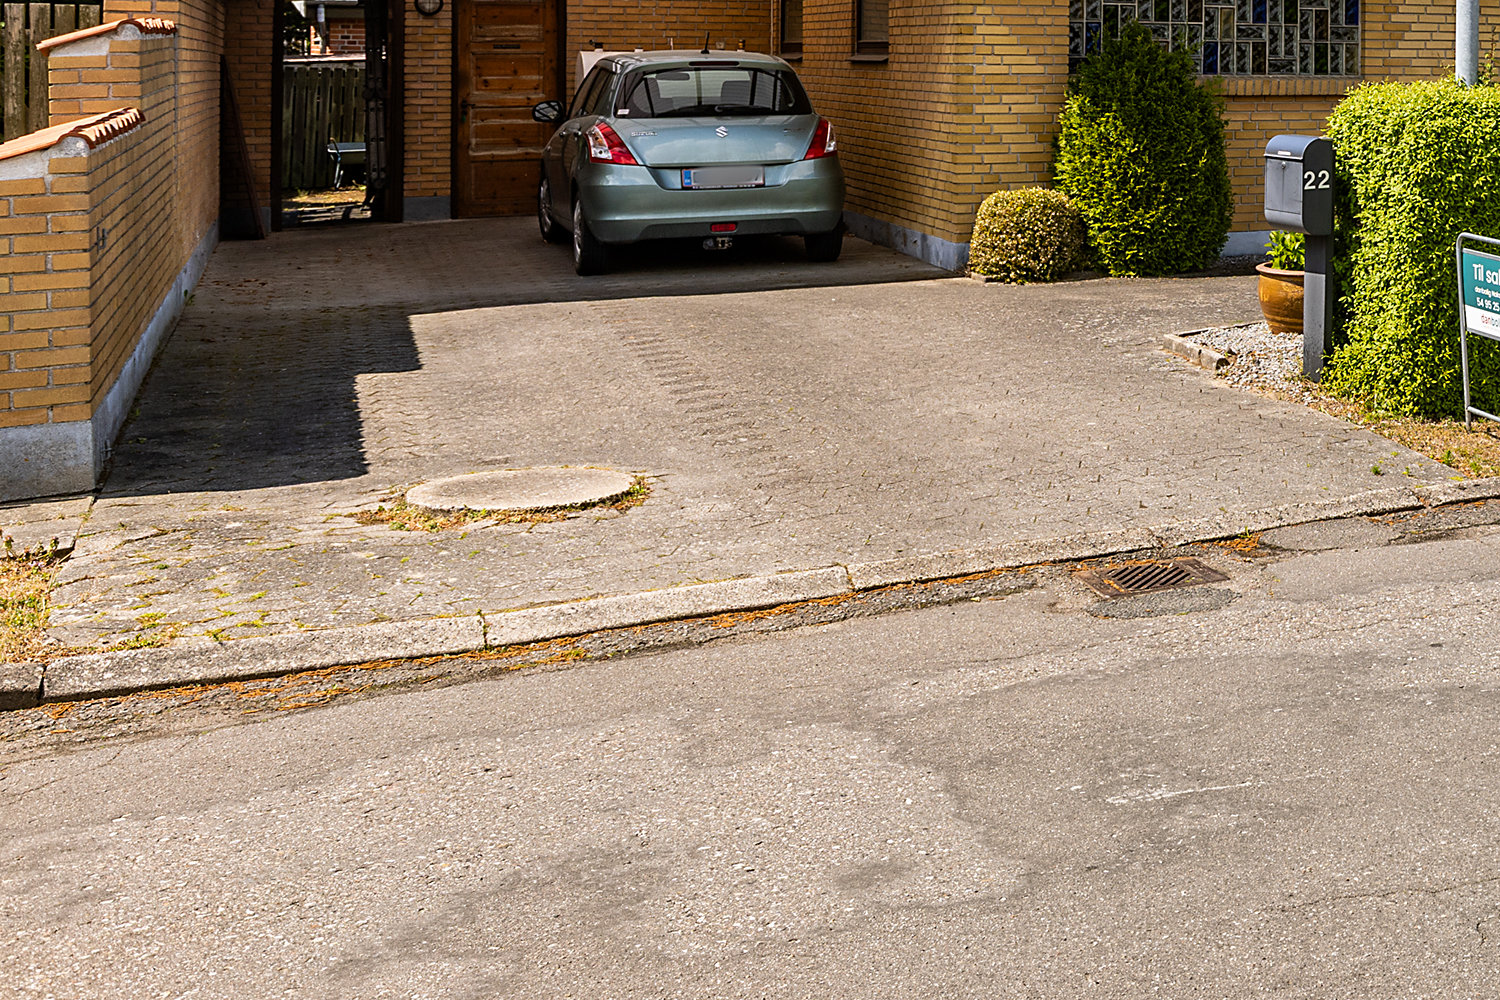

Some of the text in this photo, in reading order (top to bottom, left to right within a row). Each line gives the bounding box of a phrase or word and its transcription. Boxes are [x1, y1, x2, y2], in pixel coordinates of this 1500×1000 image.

[1304, 170, 1330, 190] 22
[1472, 263, 1484, 281] Til
[1476, 297, 1484, 307] 54
